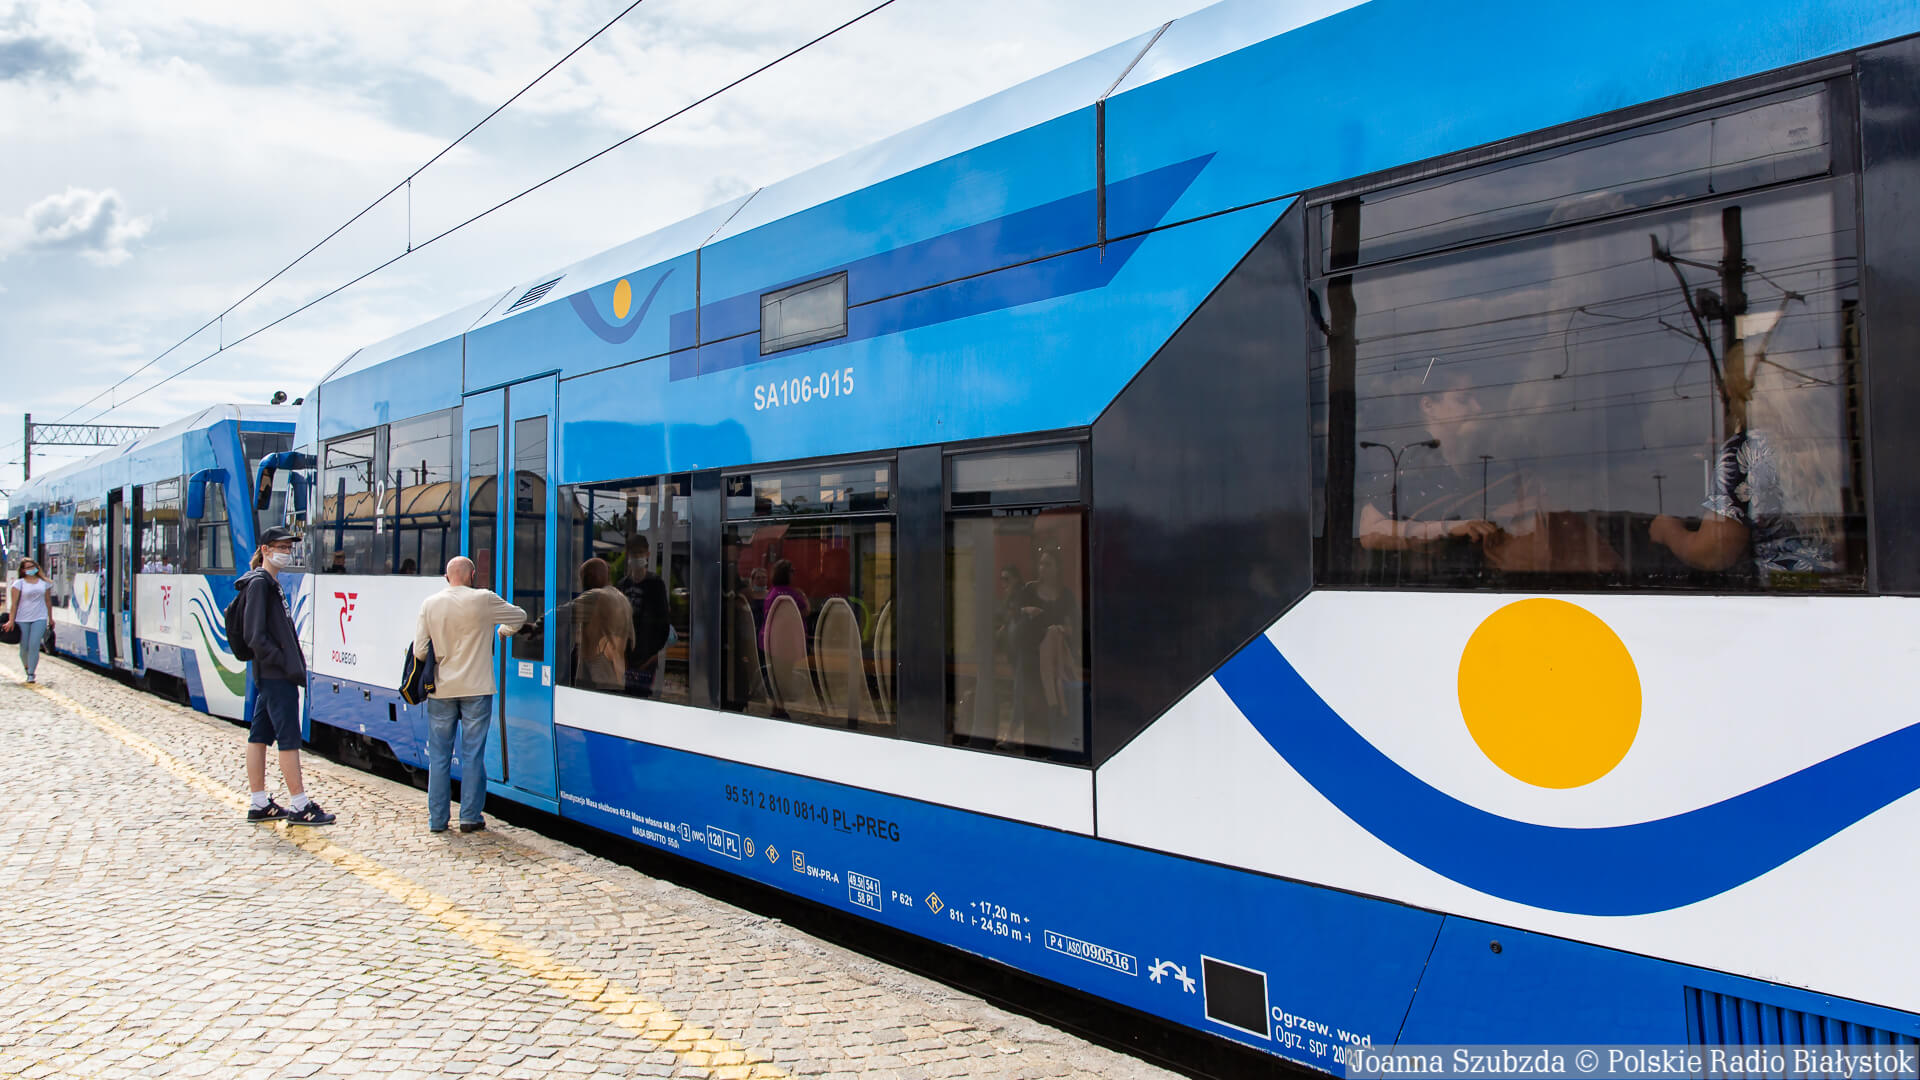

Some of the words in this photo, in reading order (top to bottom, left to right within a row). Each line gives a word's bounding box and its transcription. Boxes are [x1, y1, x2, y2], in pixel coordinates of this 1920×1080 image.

[754, 367, 854, 411] SA106-015
[376, 480, 385, 515] 2
[331, 649, 357, 666] POLREGIO
[631, 811, 645, 823] Masa
[725, 784, 739, 803] 95
[742, 788, 754, 807] 51
[759, 791, 766, 809] 2
[769, 794, 790, 815] 810
[794, 800, 828, 824] 081-0
[833, 808, 900, 842] PL-PREG
[708, 831, 722, 848] 120
[726, 837, 738, 853] PL
[806, 865, 840, 884] SW-PR-A
[891, 890, 898, 901] P
[900, 893, 913, 907] 62t
[949, 908, 964, 924] 81t
[979, 901, 1008, 920] 17,20
[1010, 911, 1021, 924] m
[980, 917, 1009, 937] 24,50
[1011, 927, 1022, 941] m
[1050, 935, 1056, 947] P
[1057, 937, 1063, 949] 4
[1271, 1006, 1333, 1038] Ogrzew.
[1337, 1028, 1376, 1051] wod.
[1275, 1025, 1306, 1049] Ogrz.
[1309, 1039, 1328, 1058] spr
